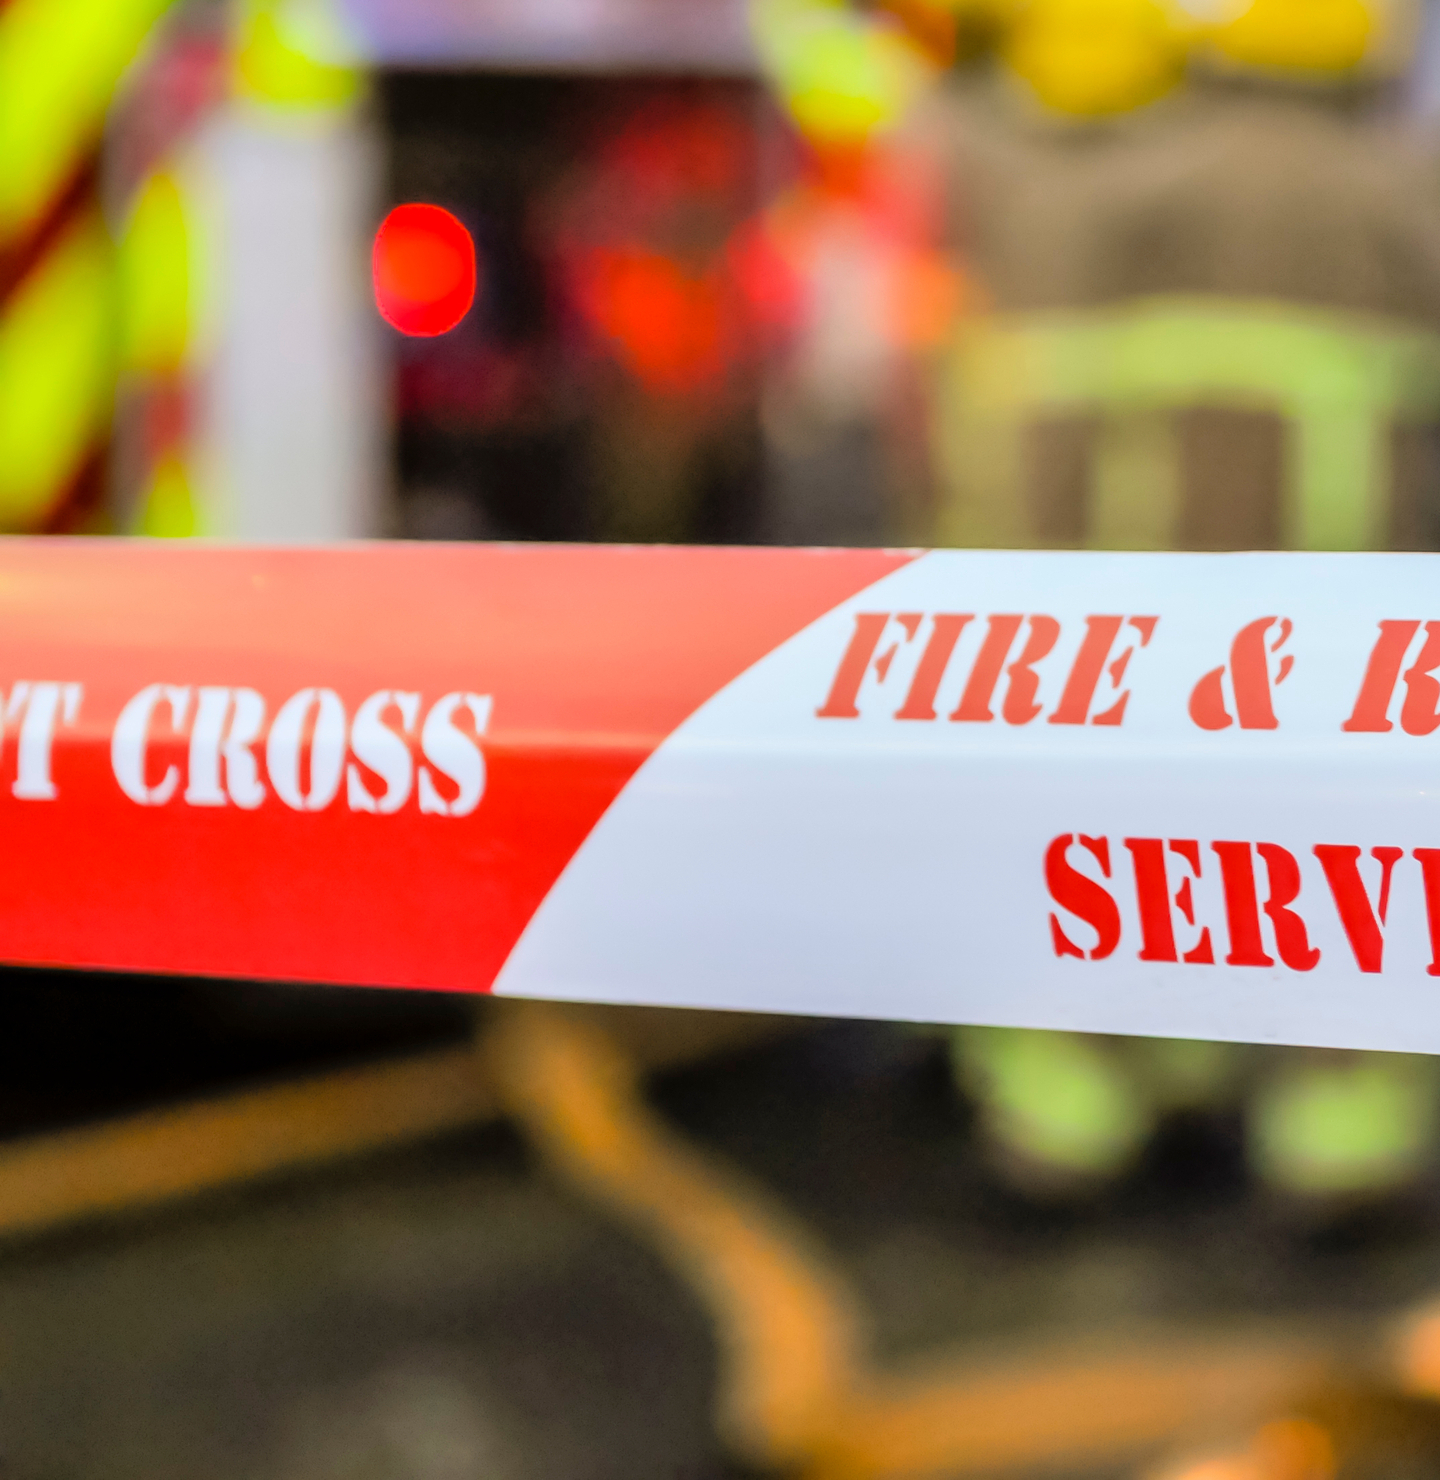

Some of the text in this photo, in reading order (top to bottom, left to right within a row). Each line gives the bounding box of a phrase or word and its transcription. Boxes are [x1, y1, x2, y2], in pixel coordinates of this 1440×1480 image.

[815, 611, 1159, 727] FIRE
[1187, 615, 1295, 732] &
[0, 680, 494, 817] T CROSS
